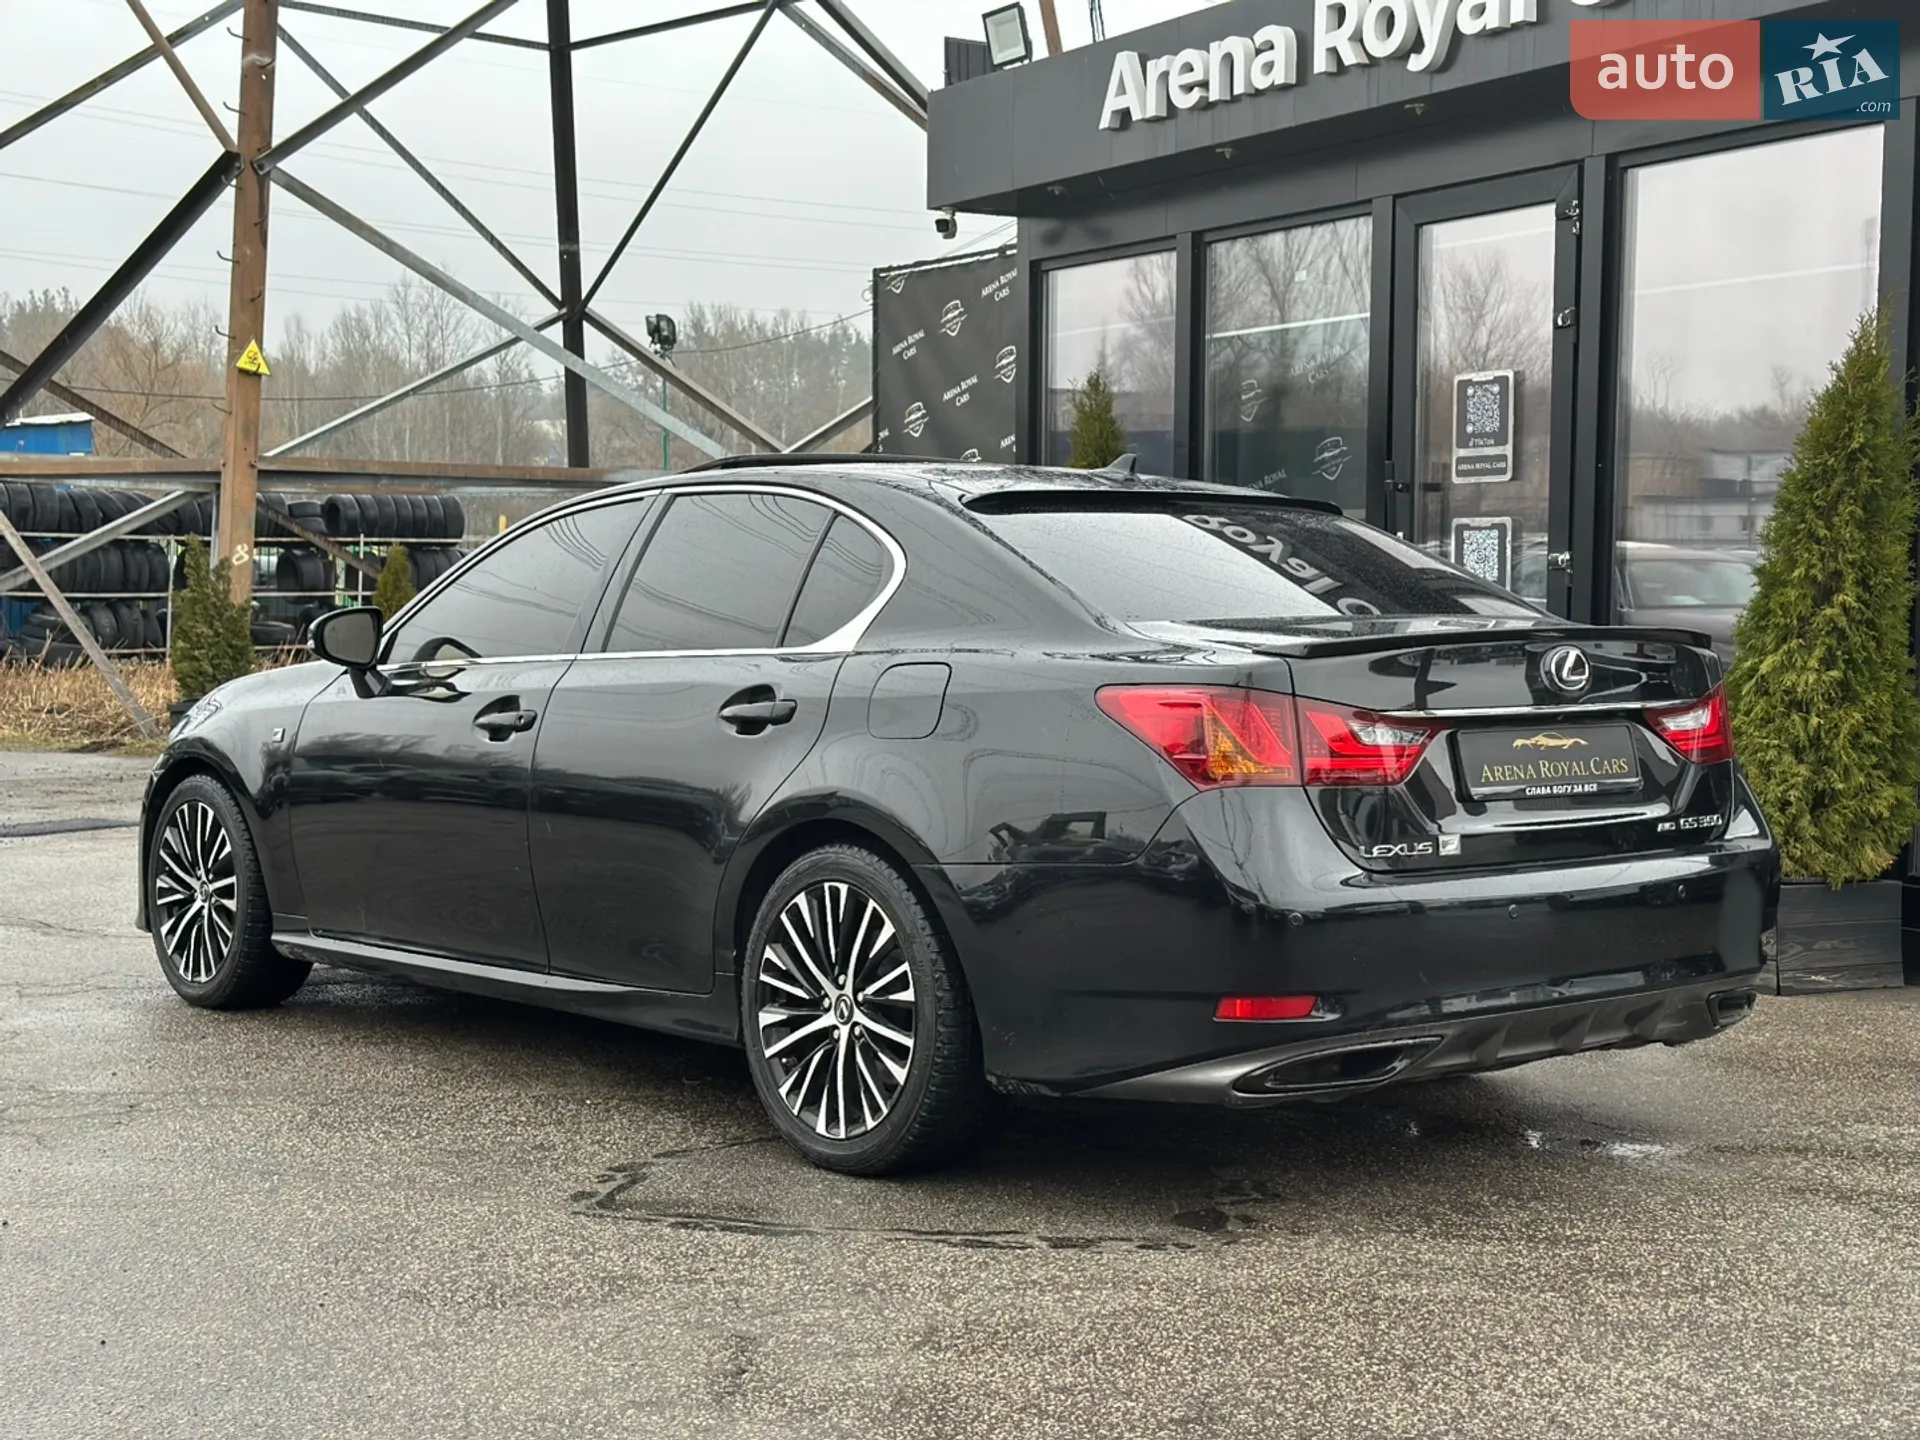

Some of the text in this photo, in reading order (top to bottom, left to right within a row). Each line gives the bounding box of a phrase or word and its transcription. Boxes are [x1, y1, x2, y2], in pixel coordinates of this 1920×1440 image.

[1099, 0, 1537, 130] Arena Roya
[981, 278, 1000, 298] ARENA
[994, 286, 1010, 302] CARS
[902, 346, 917, 360] CARS
[942, 386, 961, 402] ARENA
[956, 392, 970, 407] CARS
[1000, 433, 1016, 449] AREN
[1481, 757, 1629, 783] ARENA ROYAL CARS
[1525, 786, 1551, 796] СЛАВА
[1573, 784, 1583, 793] ЗА
[1359, 841, 1433, 858] LEXUS
